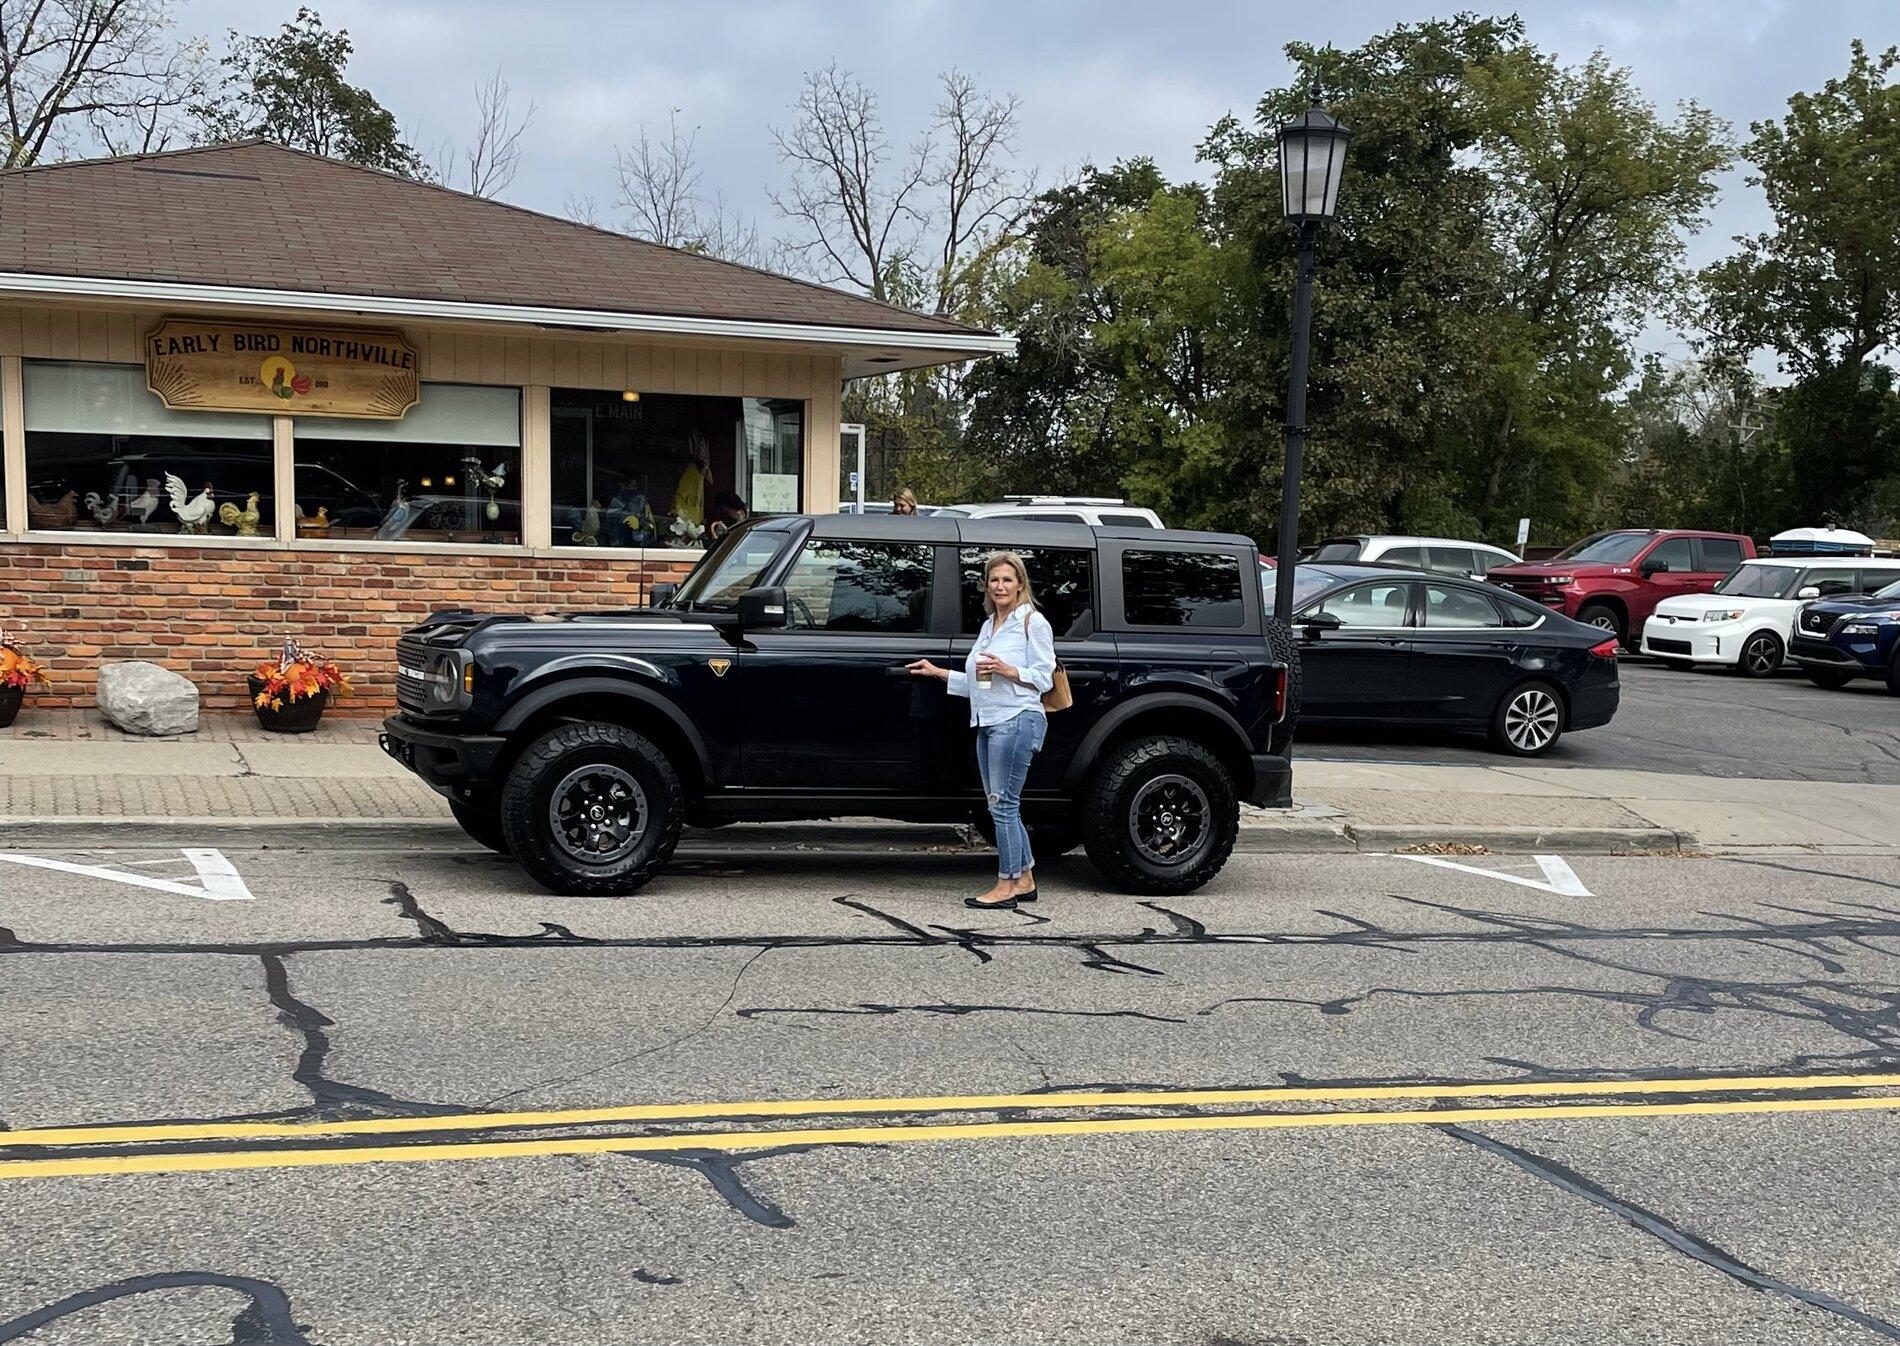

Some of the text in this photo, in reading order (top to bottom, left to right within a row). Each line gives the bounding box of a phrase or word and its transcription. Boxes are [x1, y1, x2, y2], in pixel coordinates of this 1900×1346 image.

[153, 333, 412, 370] EARLY BIRD NORTHVILLE
